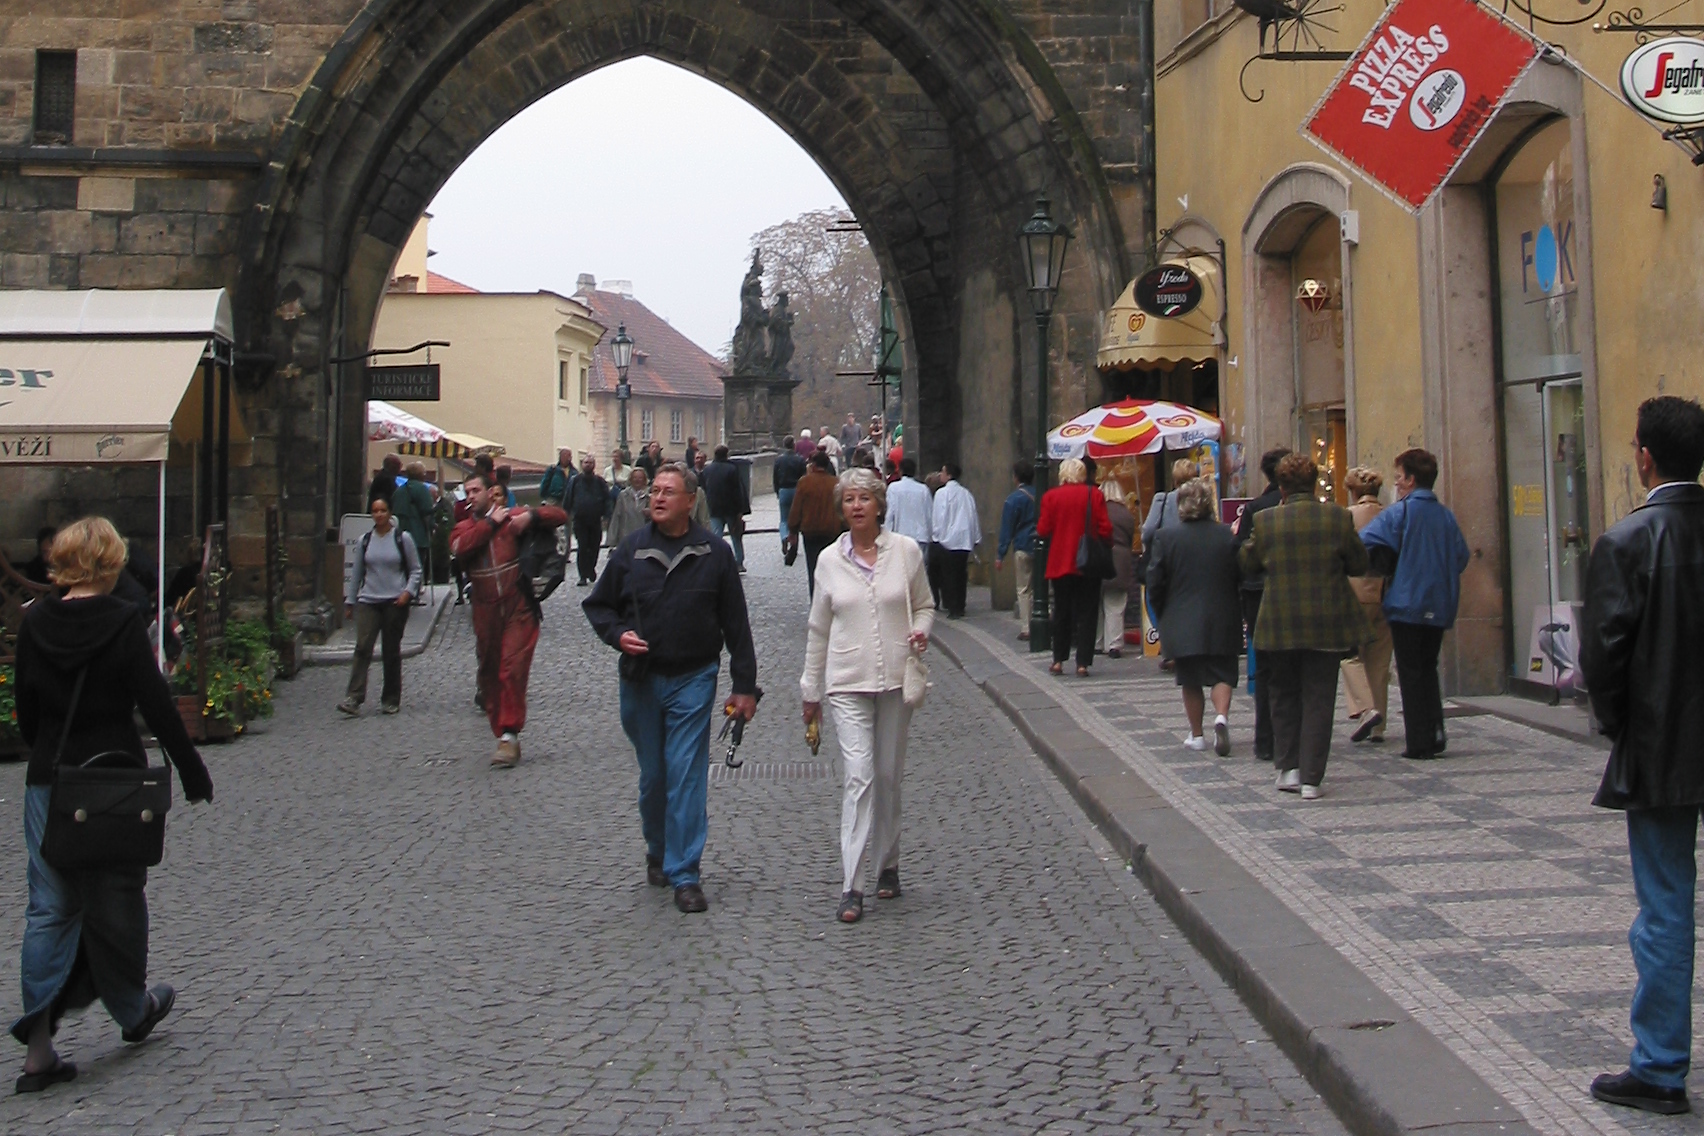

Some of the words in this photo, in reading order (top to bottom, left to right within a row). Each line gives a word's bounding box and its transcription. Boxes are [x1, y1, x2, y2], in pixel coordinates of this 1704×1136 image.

[1349, 25, 1415, 95] PIZZA
[1362, 24, 1449, 129] EXPRESS
[1417, 72, 1458, 128] Segafredo
[1156, 293, 1187, 304] ESPRESSO
[371, 385, 433, 396] INFORMACE
[1, 436, 51, 457] VĚŽÍ
